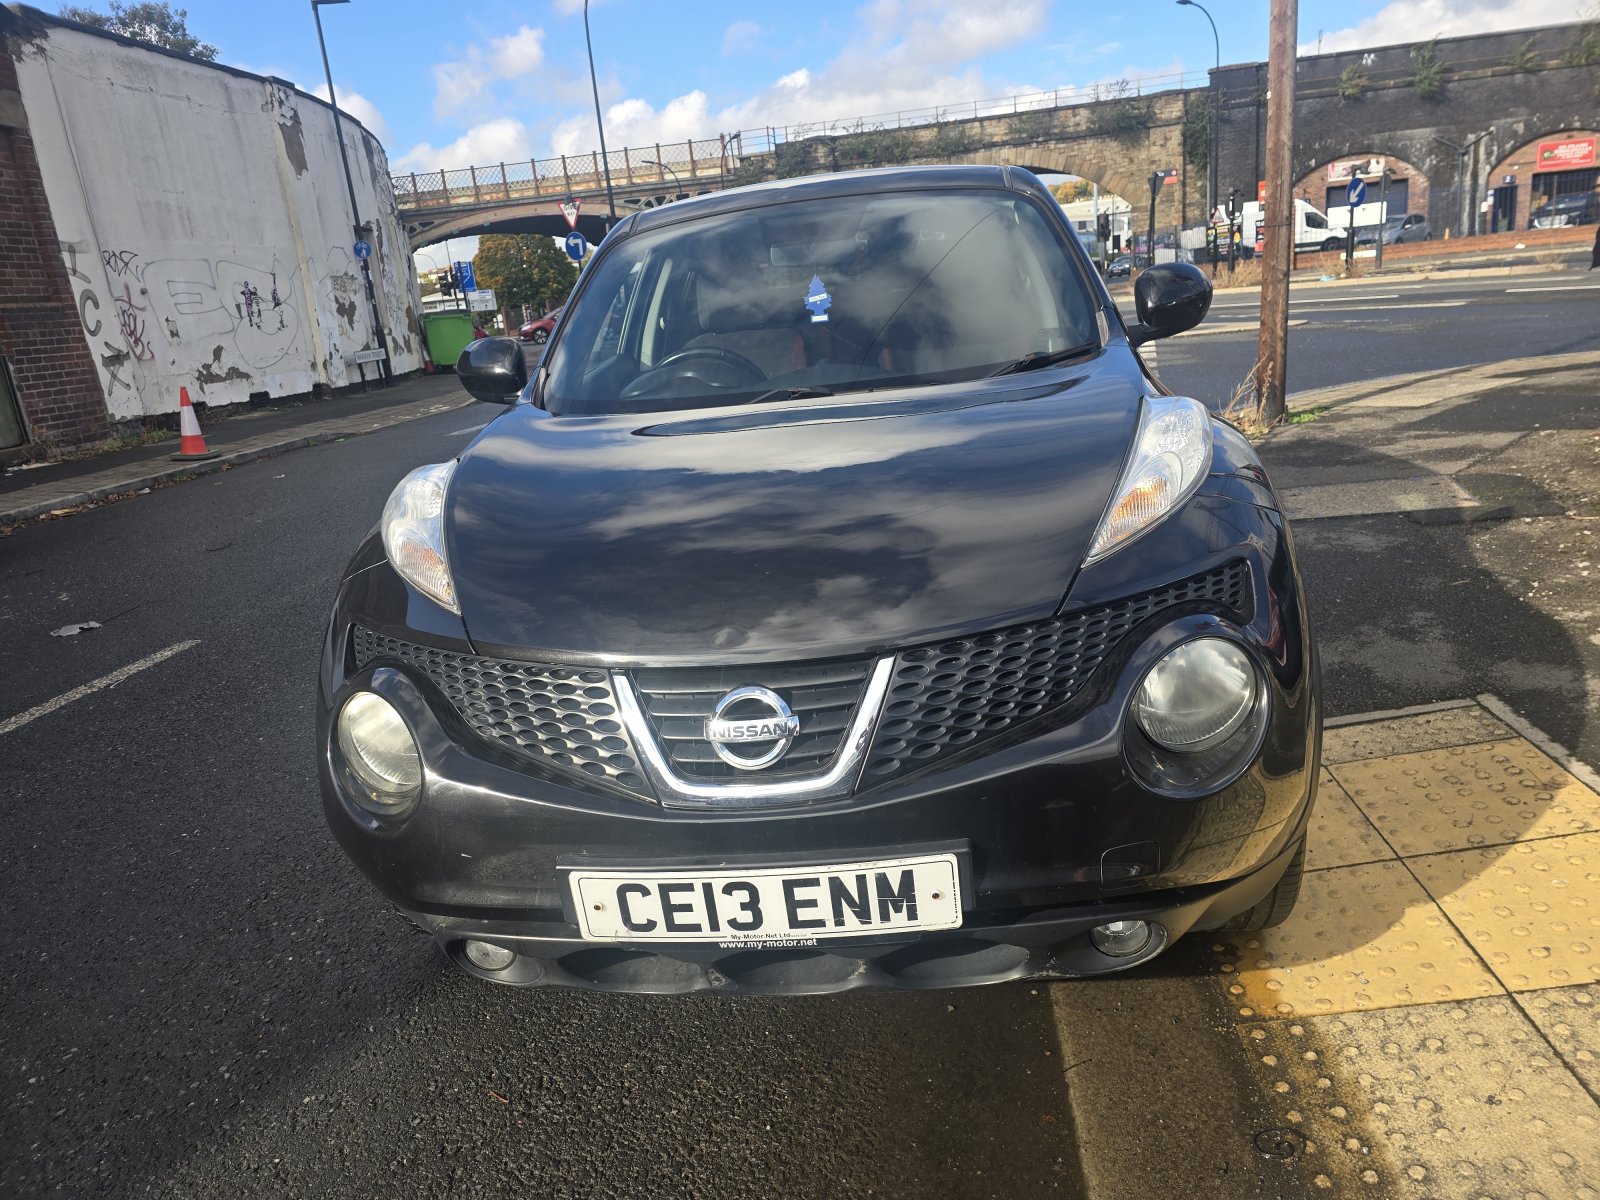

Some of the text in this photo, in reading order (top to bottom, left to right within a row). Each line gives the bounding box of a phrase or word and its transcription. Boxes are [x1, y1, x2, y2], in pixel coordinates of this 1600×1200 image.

[711, 721, 789, 738] NISSAN
[616, 881, 764, 933] CE13
[782, 869, 918, 928] ENM
[718, 938, 818, 949] www.my-motor.net
